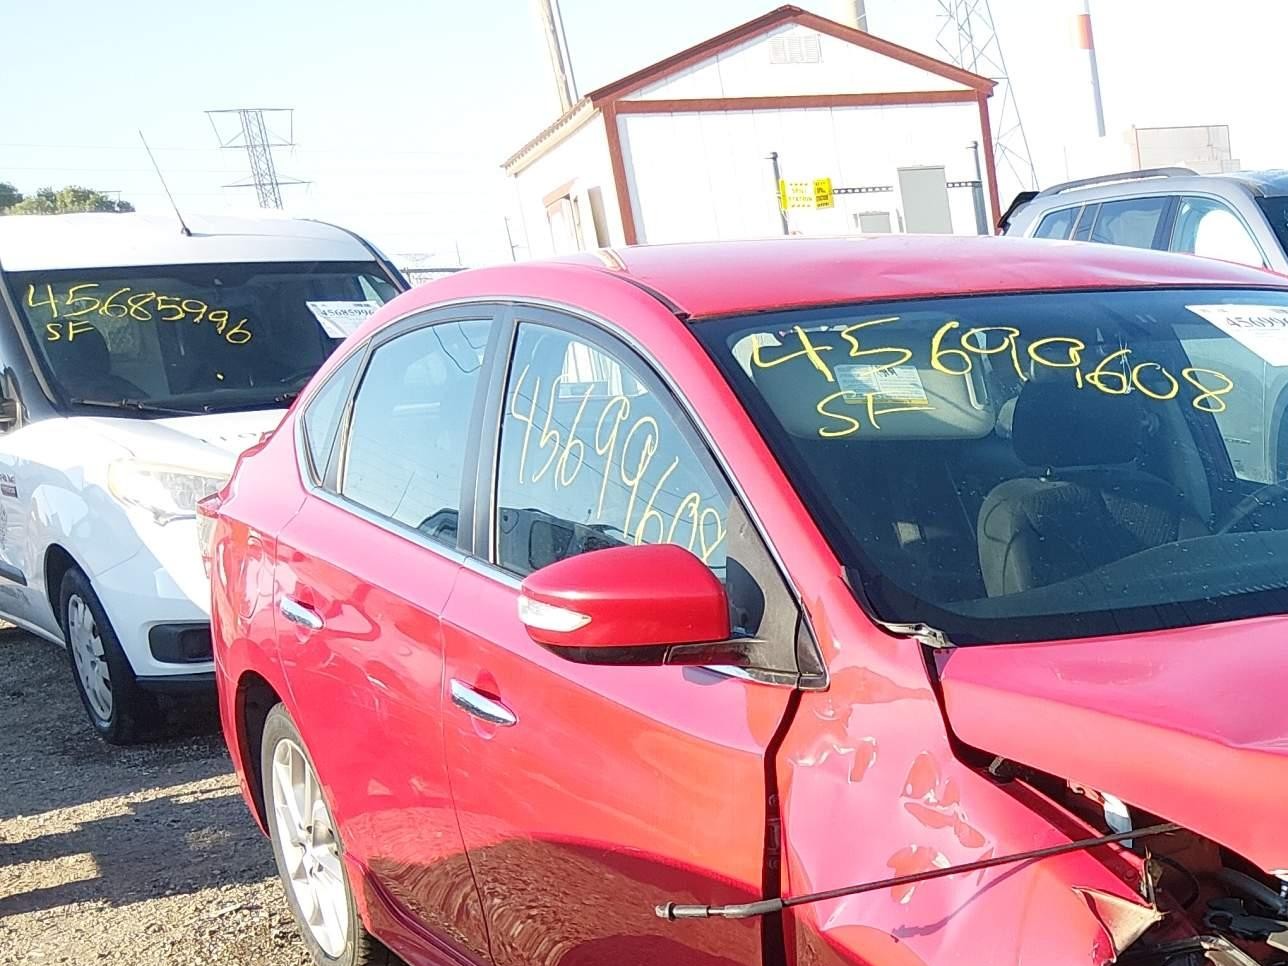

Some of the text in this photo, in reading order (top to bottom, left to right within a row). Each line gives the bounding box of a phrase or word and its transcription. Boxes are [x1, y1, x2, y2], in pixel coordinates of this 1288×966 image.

[26, 283, 252, 344] 45685996
[46, 319, 96, 342] SF
[752, 317, 1234, 412] 45699608
[817, 391, 936, 437] SF
